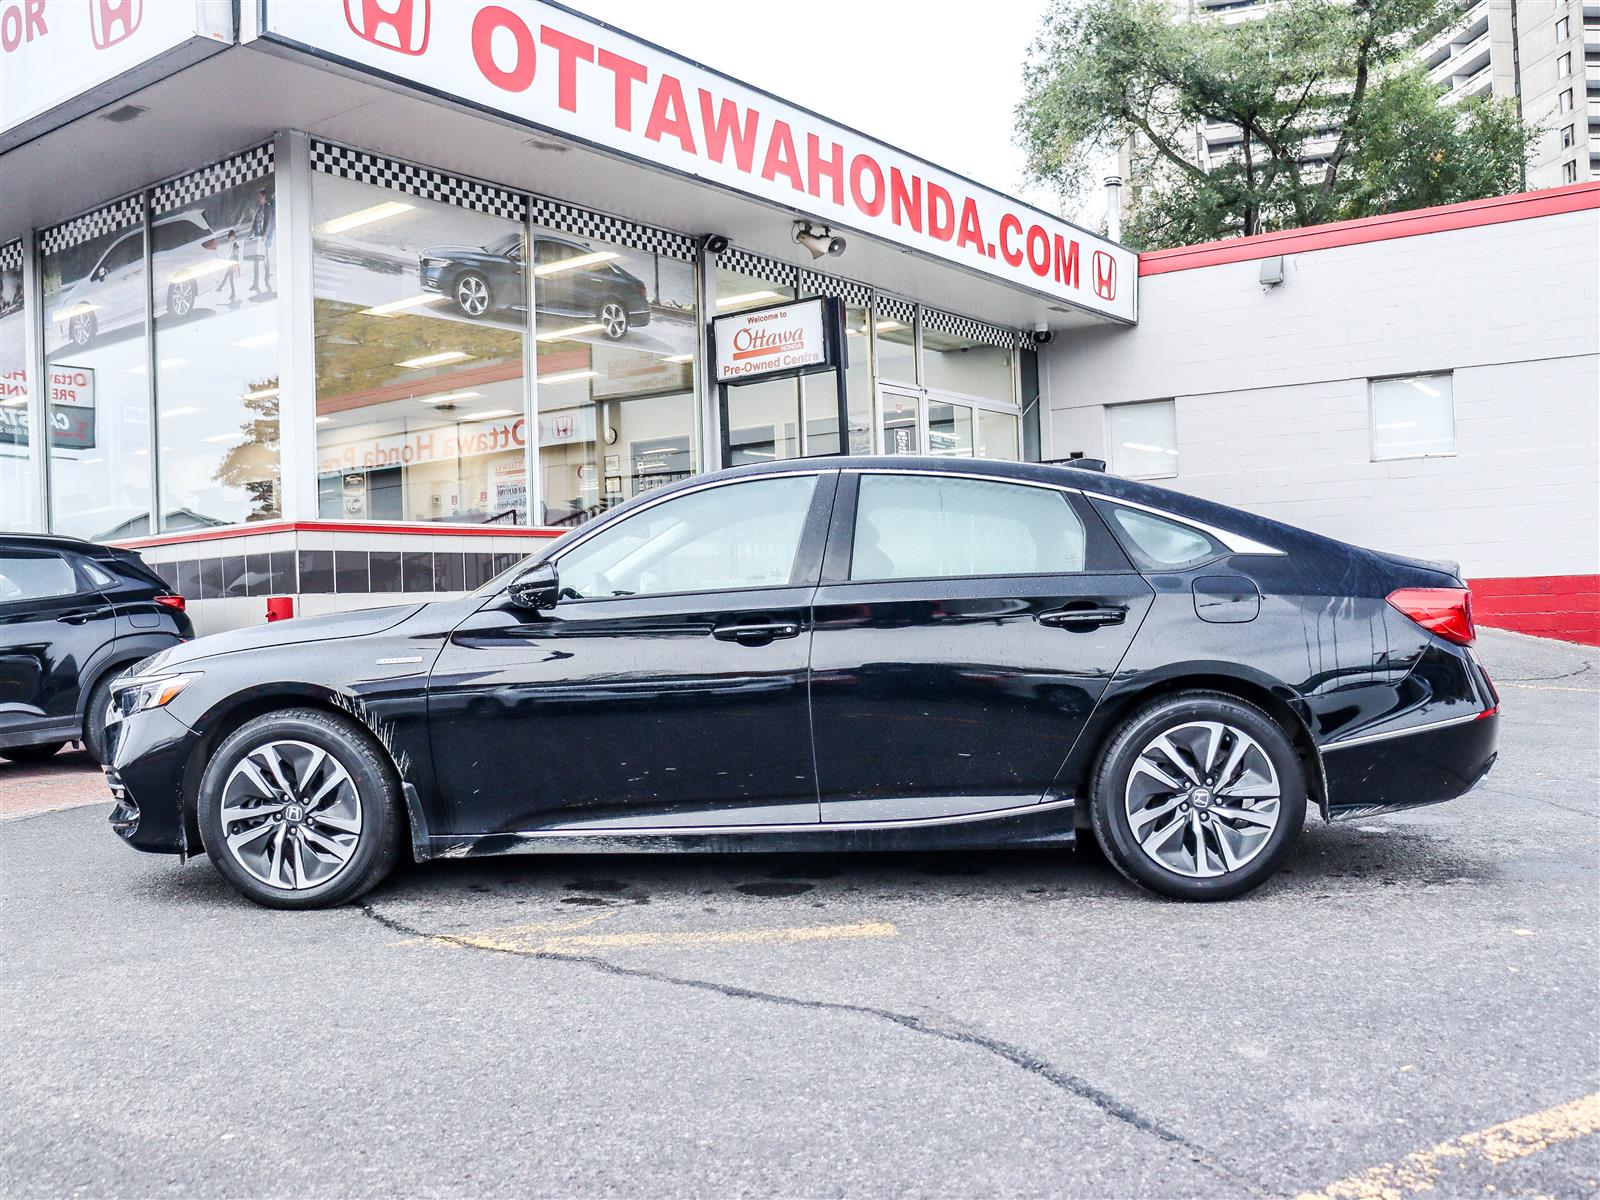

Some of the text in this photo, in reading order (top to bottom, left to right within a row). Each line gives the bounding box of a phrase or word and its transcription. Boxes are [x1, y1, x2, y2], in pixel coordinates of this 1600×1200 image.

[471, 5, 1080, 290] OTTAWAHONDA.COM
[747, 313, 779, 324] Welcome
[733, 327, 804, 351] Ottawa
[723, 352, 819, 376] Pre-Owned Centre
